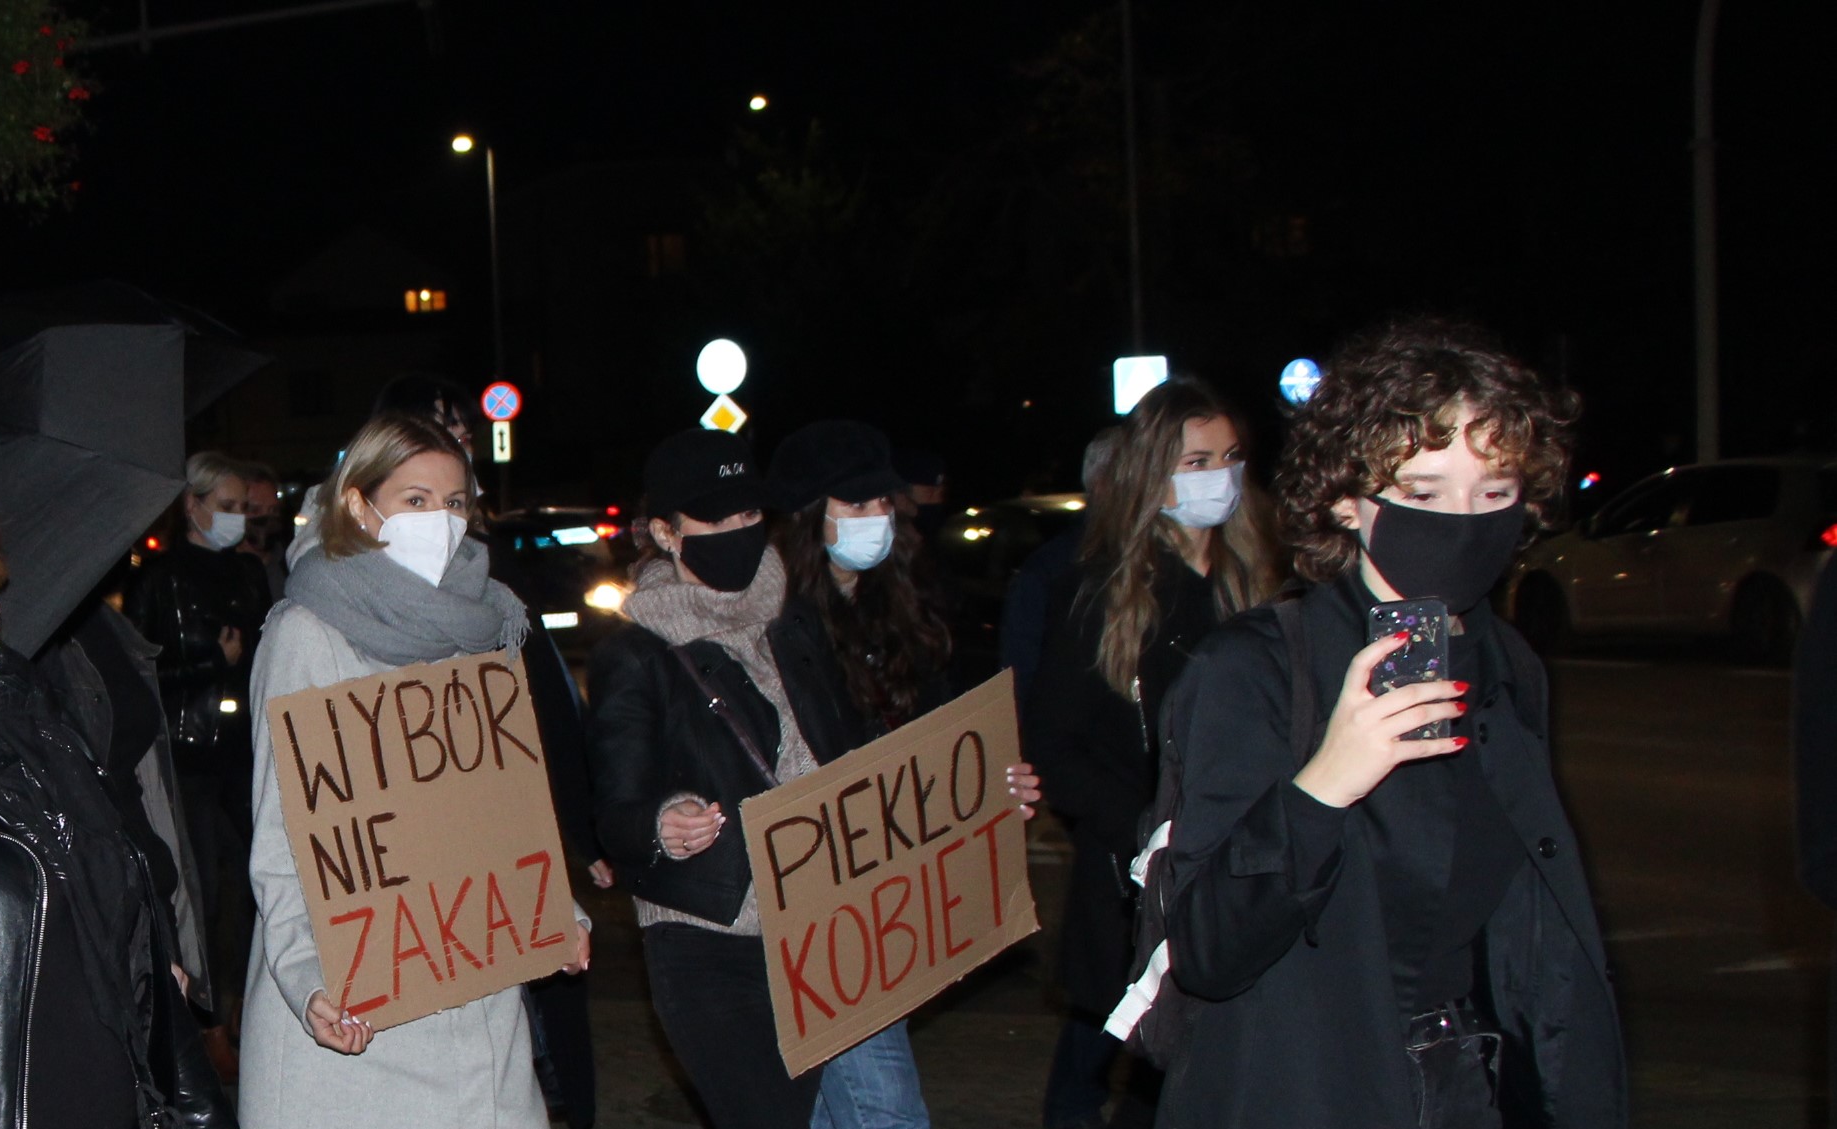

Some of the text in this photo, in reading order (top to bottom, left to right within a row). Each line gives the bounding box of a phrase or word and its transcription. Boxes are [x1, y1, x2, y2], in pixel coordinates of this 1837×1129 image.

[281, 661, 539, 814] WYBÓR
[764, 730, 987, 912] PIEKŁO
[308, 812, 411, 900] NIE
[328, 850, 566, 1017] ZAKAZ
[780, 808, 1015, 1038] KOBIET
